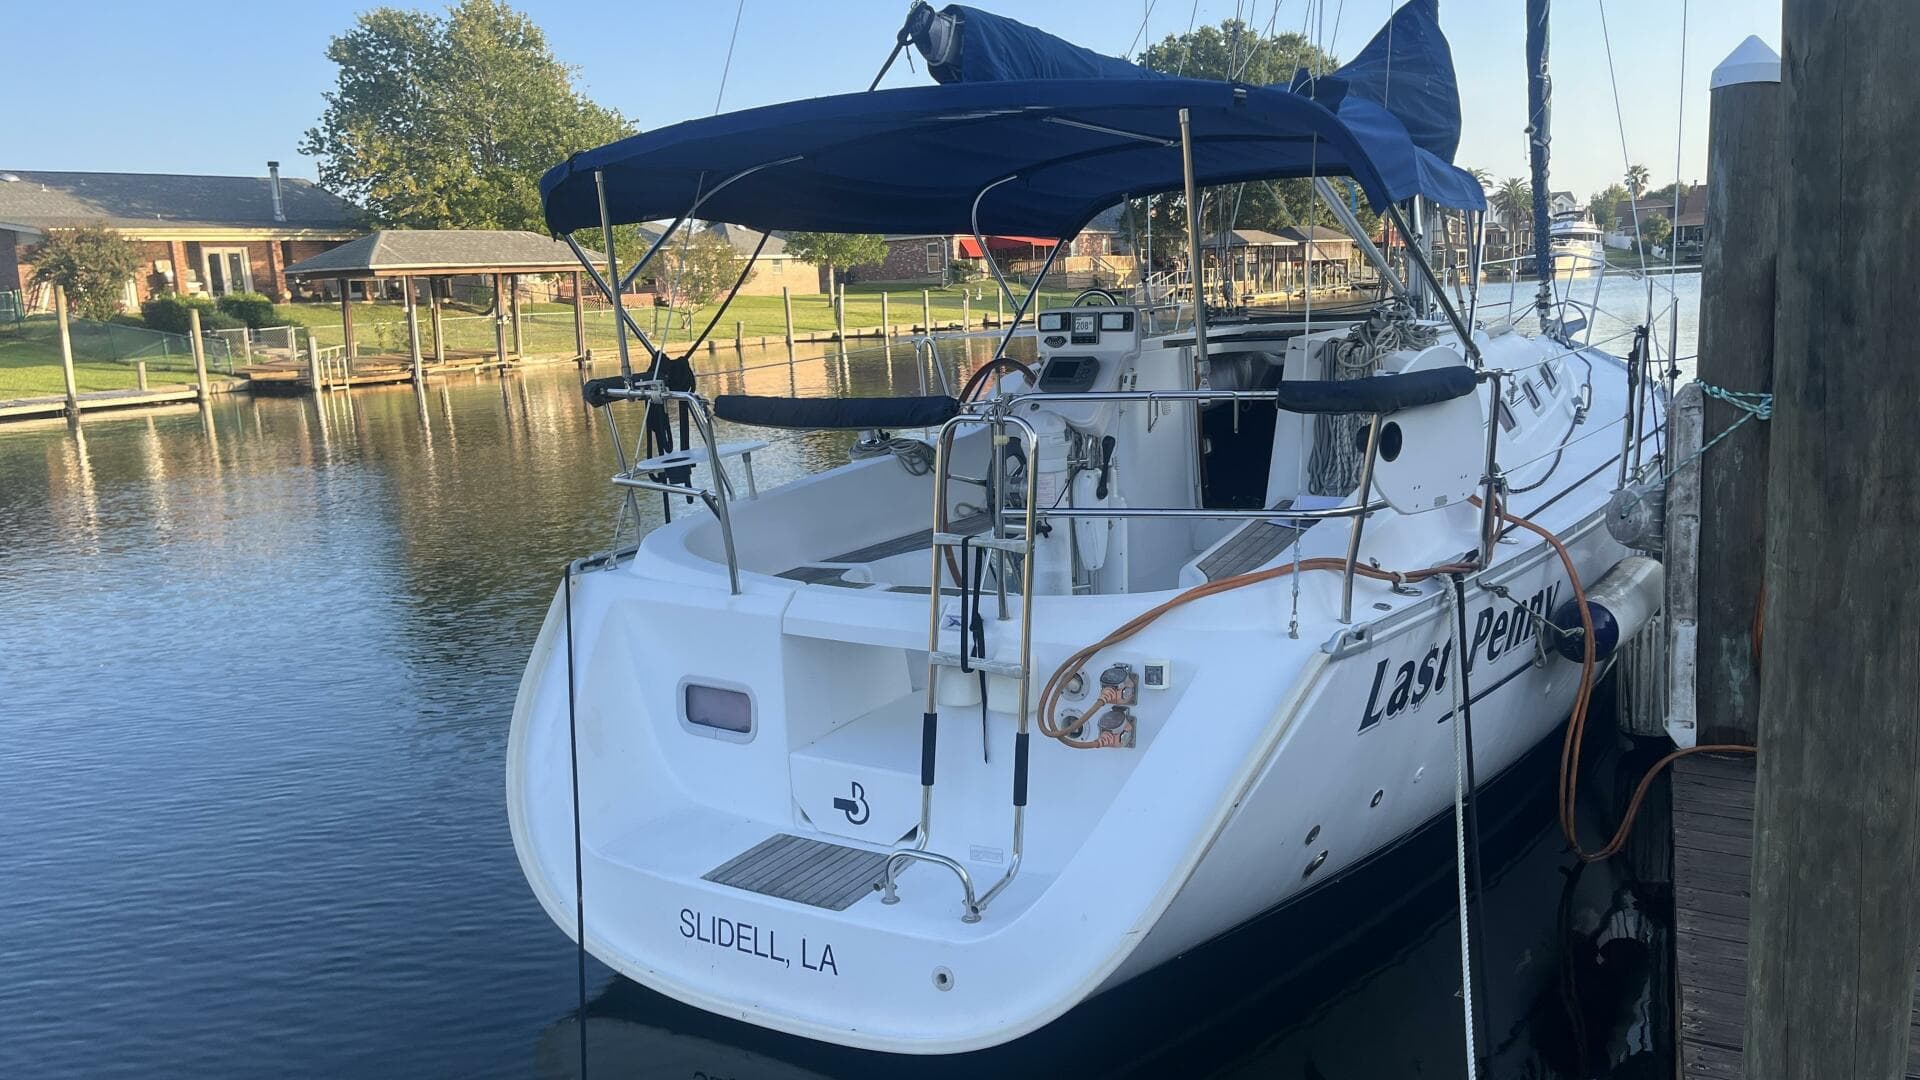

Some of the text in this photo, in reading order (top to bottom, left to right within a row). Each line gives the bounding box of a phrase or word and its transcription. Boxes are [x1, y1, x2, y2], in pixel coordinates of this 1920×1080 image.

[1467, 580, 1561, 675] Penny
[679, 908, 839, 976] SLIDELL, LA
